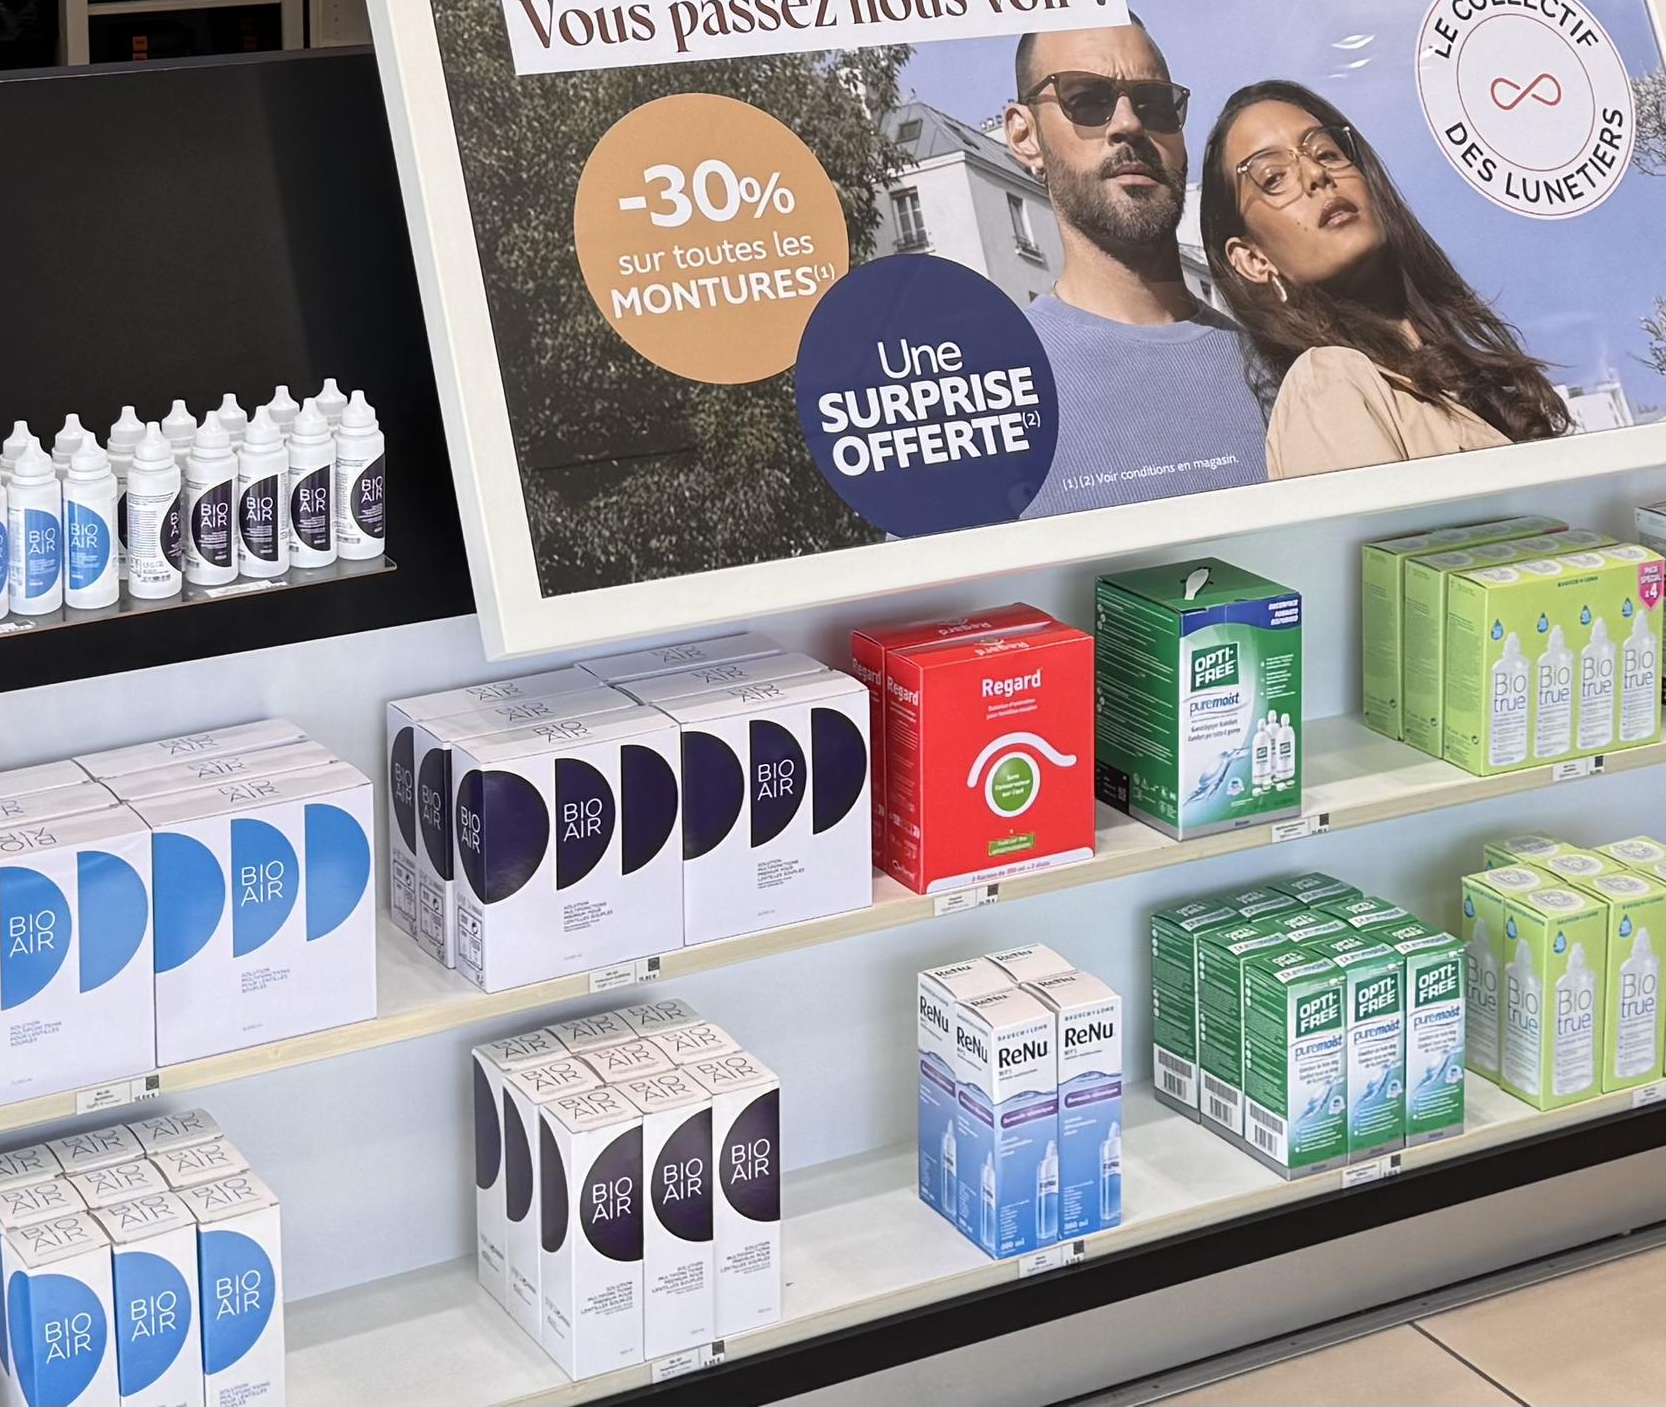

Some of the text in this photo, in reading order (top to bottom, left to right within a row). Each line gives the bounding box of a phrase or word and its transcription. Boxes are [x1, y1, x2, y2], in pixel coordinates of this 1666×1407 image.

[1434, 17, 1459, 59] LE
[1445, 106, 1624, 205] DES LUNETIERS
[617, 158, 796, 229] -30%
[618, 231, 815, 277] sur toutes les
[876, 337, 963, 380] Une
[817, 365, 1040, 434] SURPRISE
[1096, 470, 1119, 484] Voir
[1120, 462, 1176, 481] conditions
[1177, 461, 1192, 473] en
[299, 486, 327, 504] BIO
[299, 498, 326, 513] AIR
[200, 501, 230, 519] BIO
[200, 514, 230, 530] AIR
[70, 521, 98, 538] BIO
[70, 534, 98, 549] AIR
[1195, 646, 1235, 673] OPTI-
[1195, 659, 1236, 687] FREE
[1624, 649, 1655, 672] Bio
[886, 675, 919, 706] Regard
[981, 667, 1042, 698] Regard
[1539, 665, 1571, 689] Bio
[1623, 670, 1654, 690] true
[1190, 691, 1240, 717] puremoist
[1538, 687, 1571, 706] true
[757, 758, 795, 782] BIO
[757, 777, 795, 801] AIR
[460, 804, 482, 834] BIO
[563, 797, 603, 823] BIO
[461, 825, 482, 854] AIR
[563, 817, 603, 843] AIR
[240, 858, 286, 885] BIO
[240, 880, 284, 907] AIR
[9, 908, 57, 937] BIO
[9, 931, 55, 959] AIR
[1418, 965, 1457, 991] OPTI-
[1419, 977, 1458, 1004] FREE
[1621, 972, 1657, 1003] Bio
[919, 994, 950, 1034] ReNu
[1298, 995, 1339, 1019] OPTI-
[1557, 987, 1593, 1018] Bio
[1621, 996, 1655, 1018] true
[1299, 1007, 1340, 1034] FREE
[1557, 1013, 1592, 1033] true
[956, 1025, 989, 1065] ReNu
[1064, 1021, 1114, 1048] ReNu
[998, 1040, 1048, 1069] ReNu
[731, 1137, 771, 1165] BIO
[731, 1157, 771, 1185] AIR
[591, 1176, 633, 1205] BIO
[591, 1197, 632, 1225] AIR
[216, 1269, 262, 1300] BIO
[216, 1290, 261, 1322] AIR
[44, 1312, 92, 1345] BIO
[45, 1333, 92, 1365] AIR
